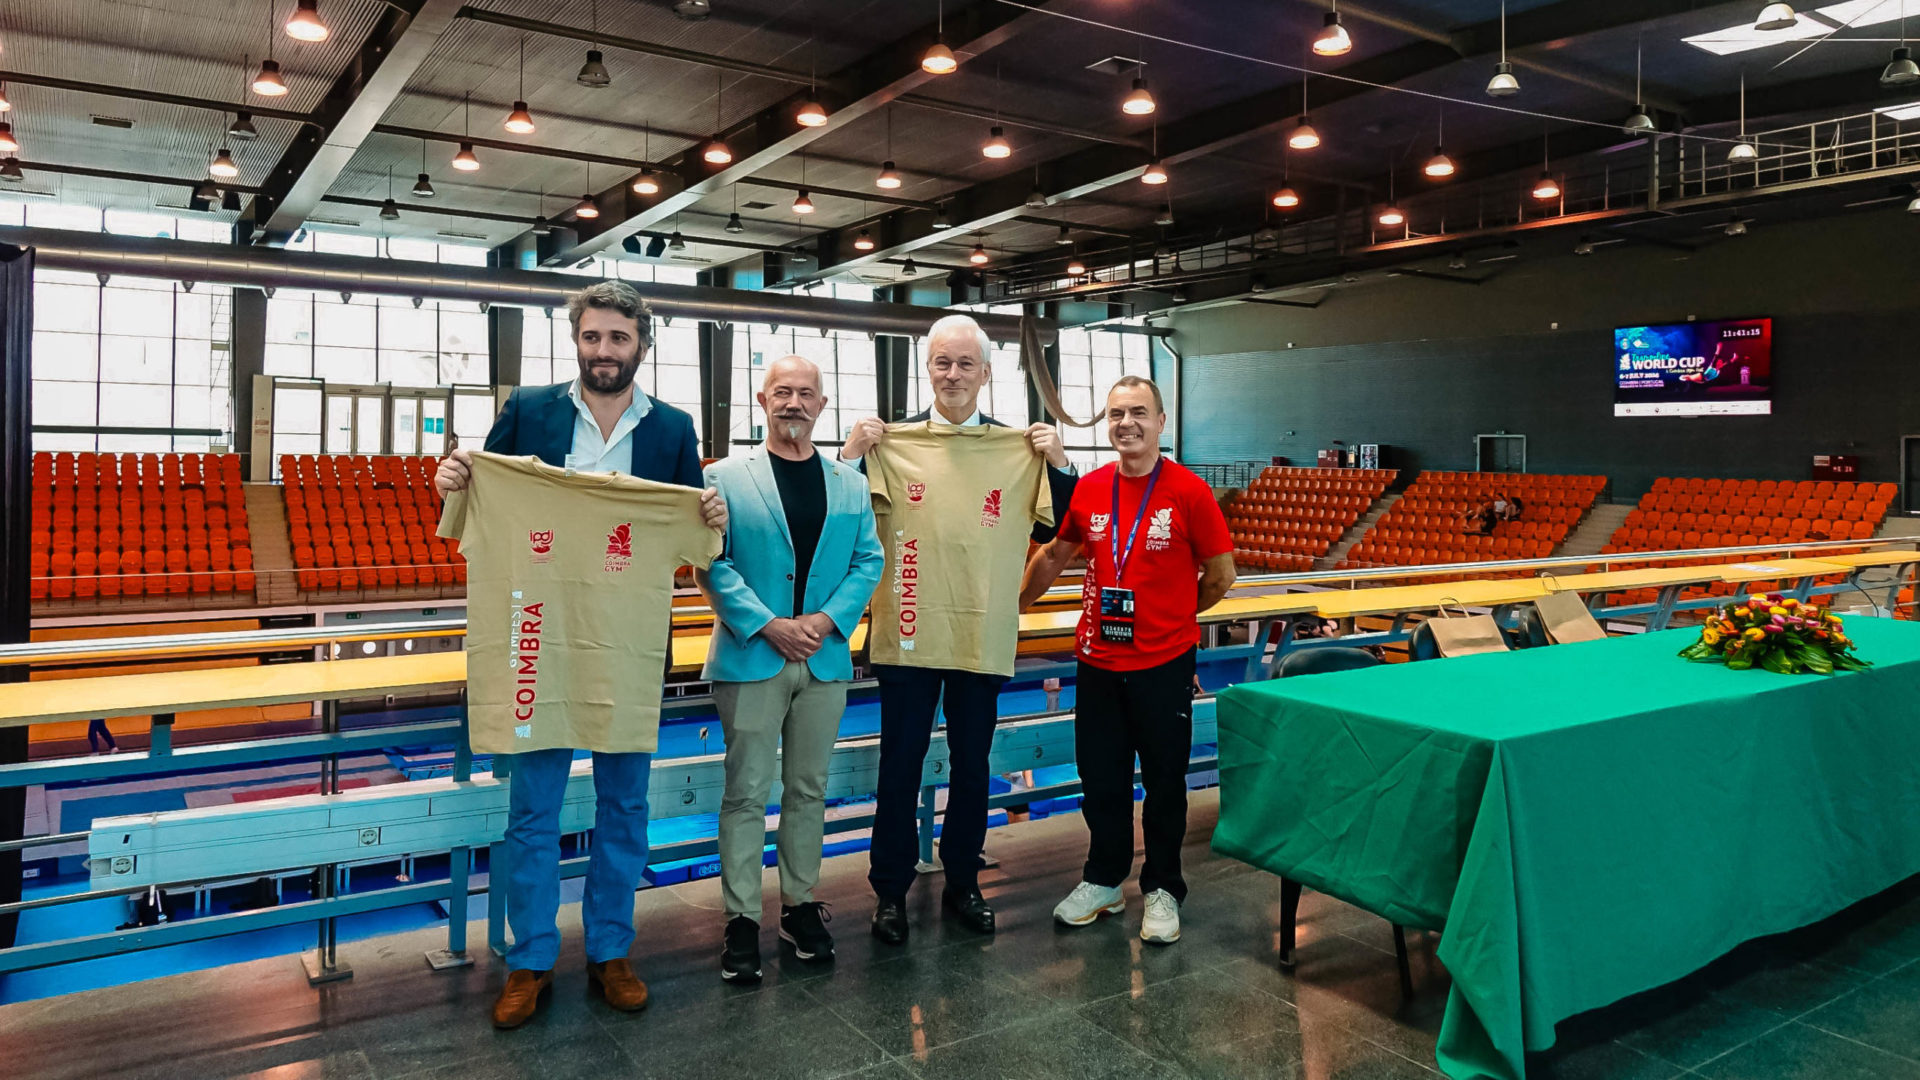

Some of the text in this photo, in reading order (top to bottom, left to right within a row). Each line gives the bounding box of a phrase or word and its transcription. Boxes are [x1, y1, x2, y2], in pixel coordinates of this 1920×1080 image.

[1723, 328, 1760, 338] 11:41:15
[1632, 356, 1705, 370] WORLD CUP
[899, 538, 918, 637] COIMBRA
[515, 602, 544, 721] COIMBRA
